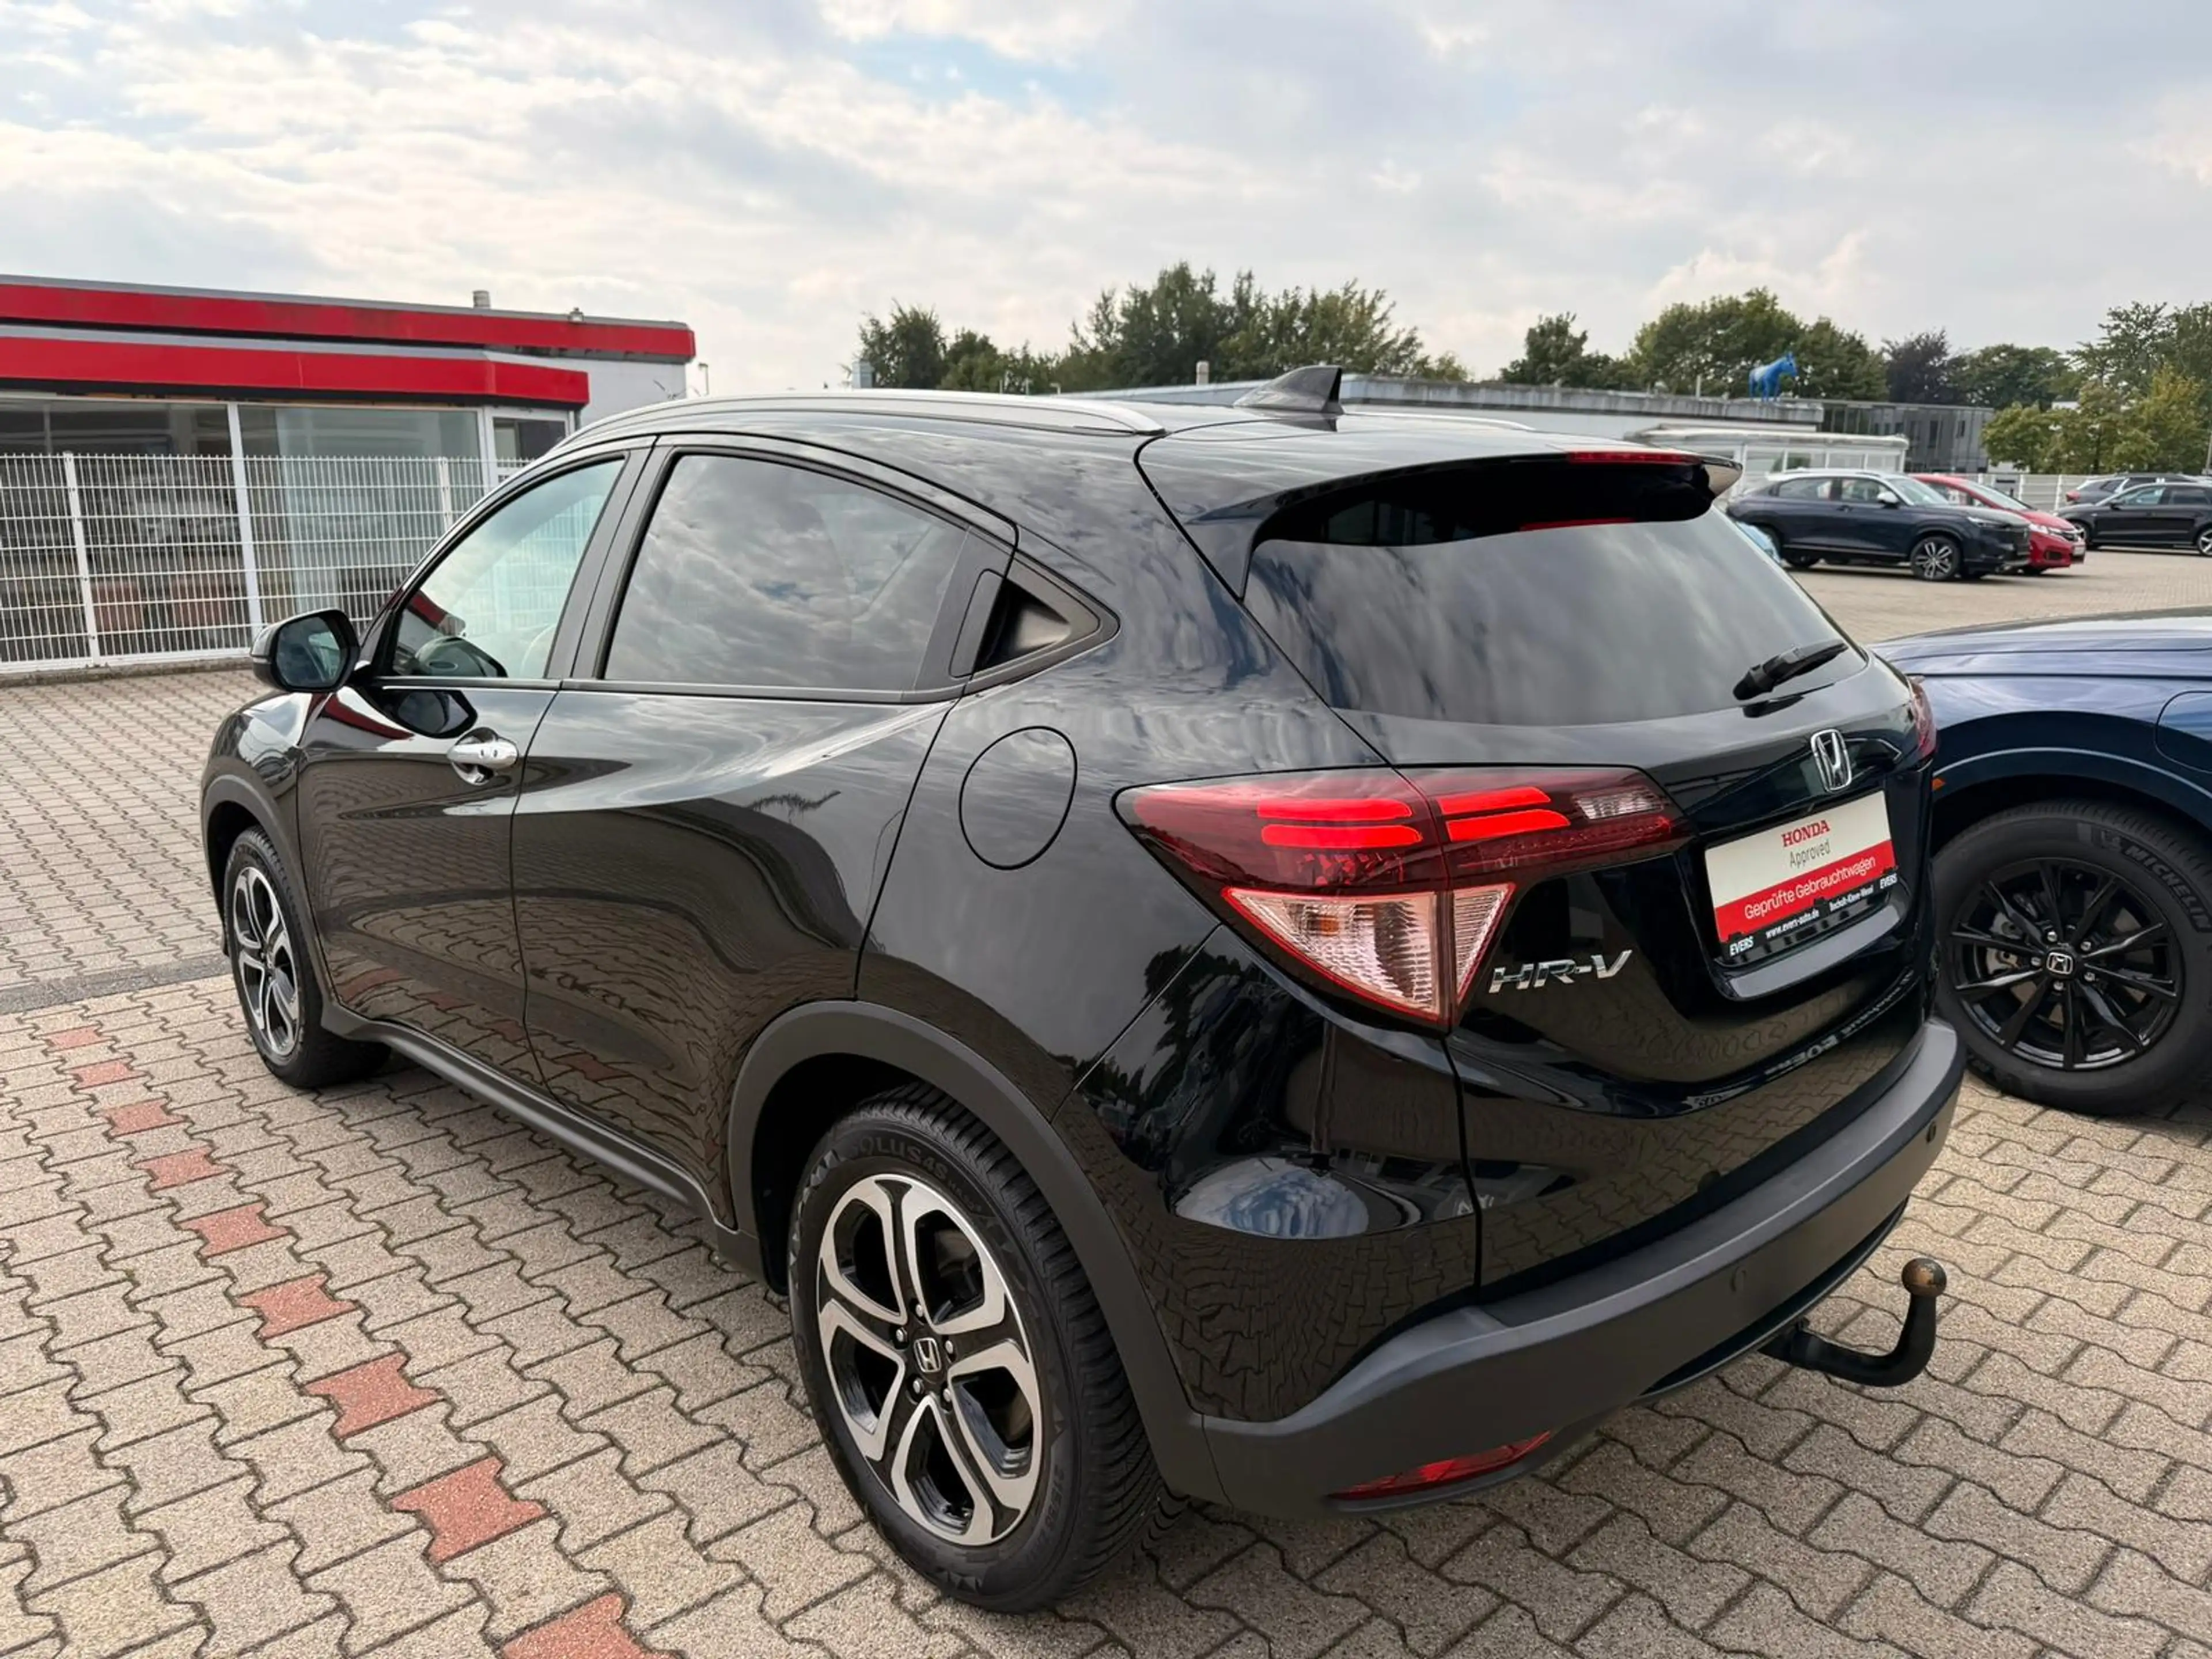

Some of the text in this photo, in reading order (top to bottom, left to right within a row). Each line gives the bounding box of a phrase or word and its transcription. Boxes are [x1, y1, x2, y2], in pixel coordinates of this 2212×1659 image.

[1781, 820, 1831, 847] HONDA
[1790, 839, 1831, 868] Approved
[1744, 890, 1796, 919] Geprüfte
[1795, 856, 1876, 899] Gebrauchtwagen
[2124, 846, 2212, 929] MICHELIN
[1729, 935, 1754, 956] EVERS
[1488, 949, 1633, 994] HR-V
